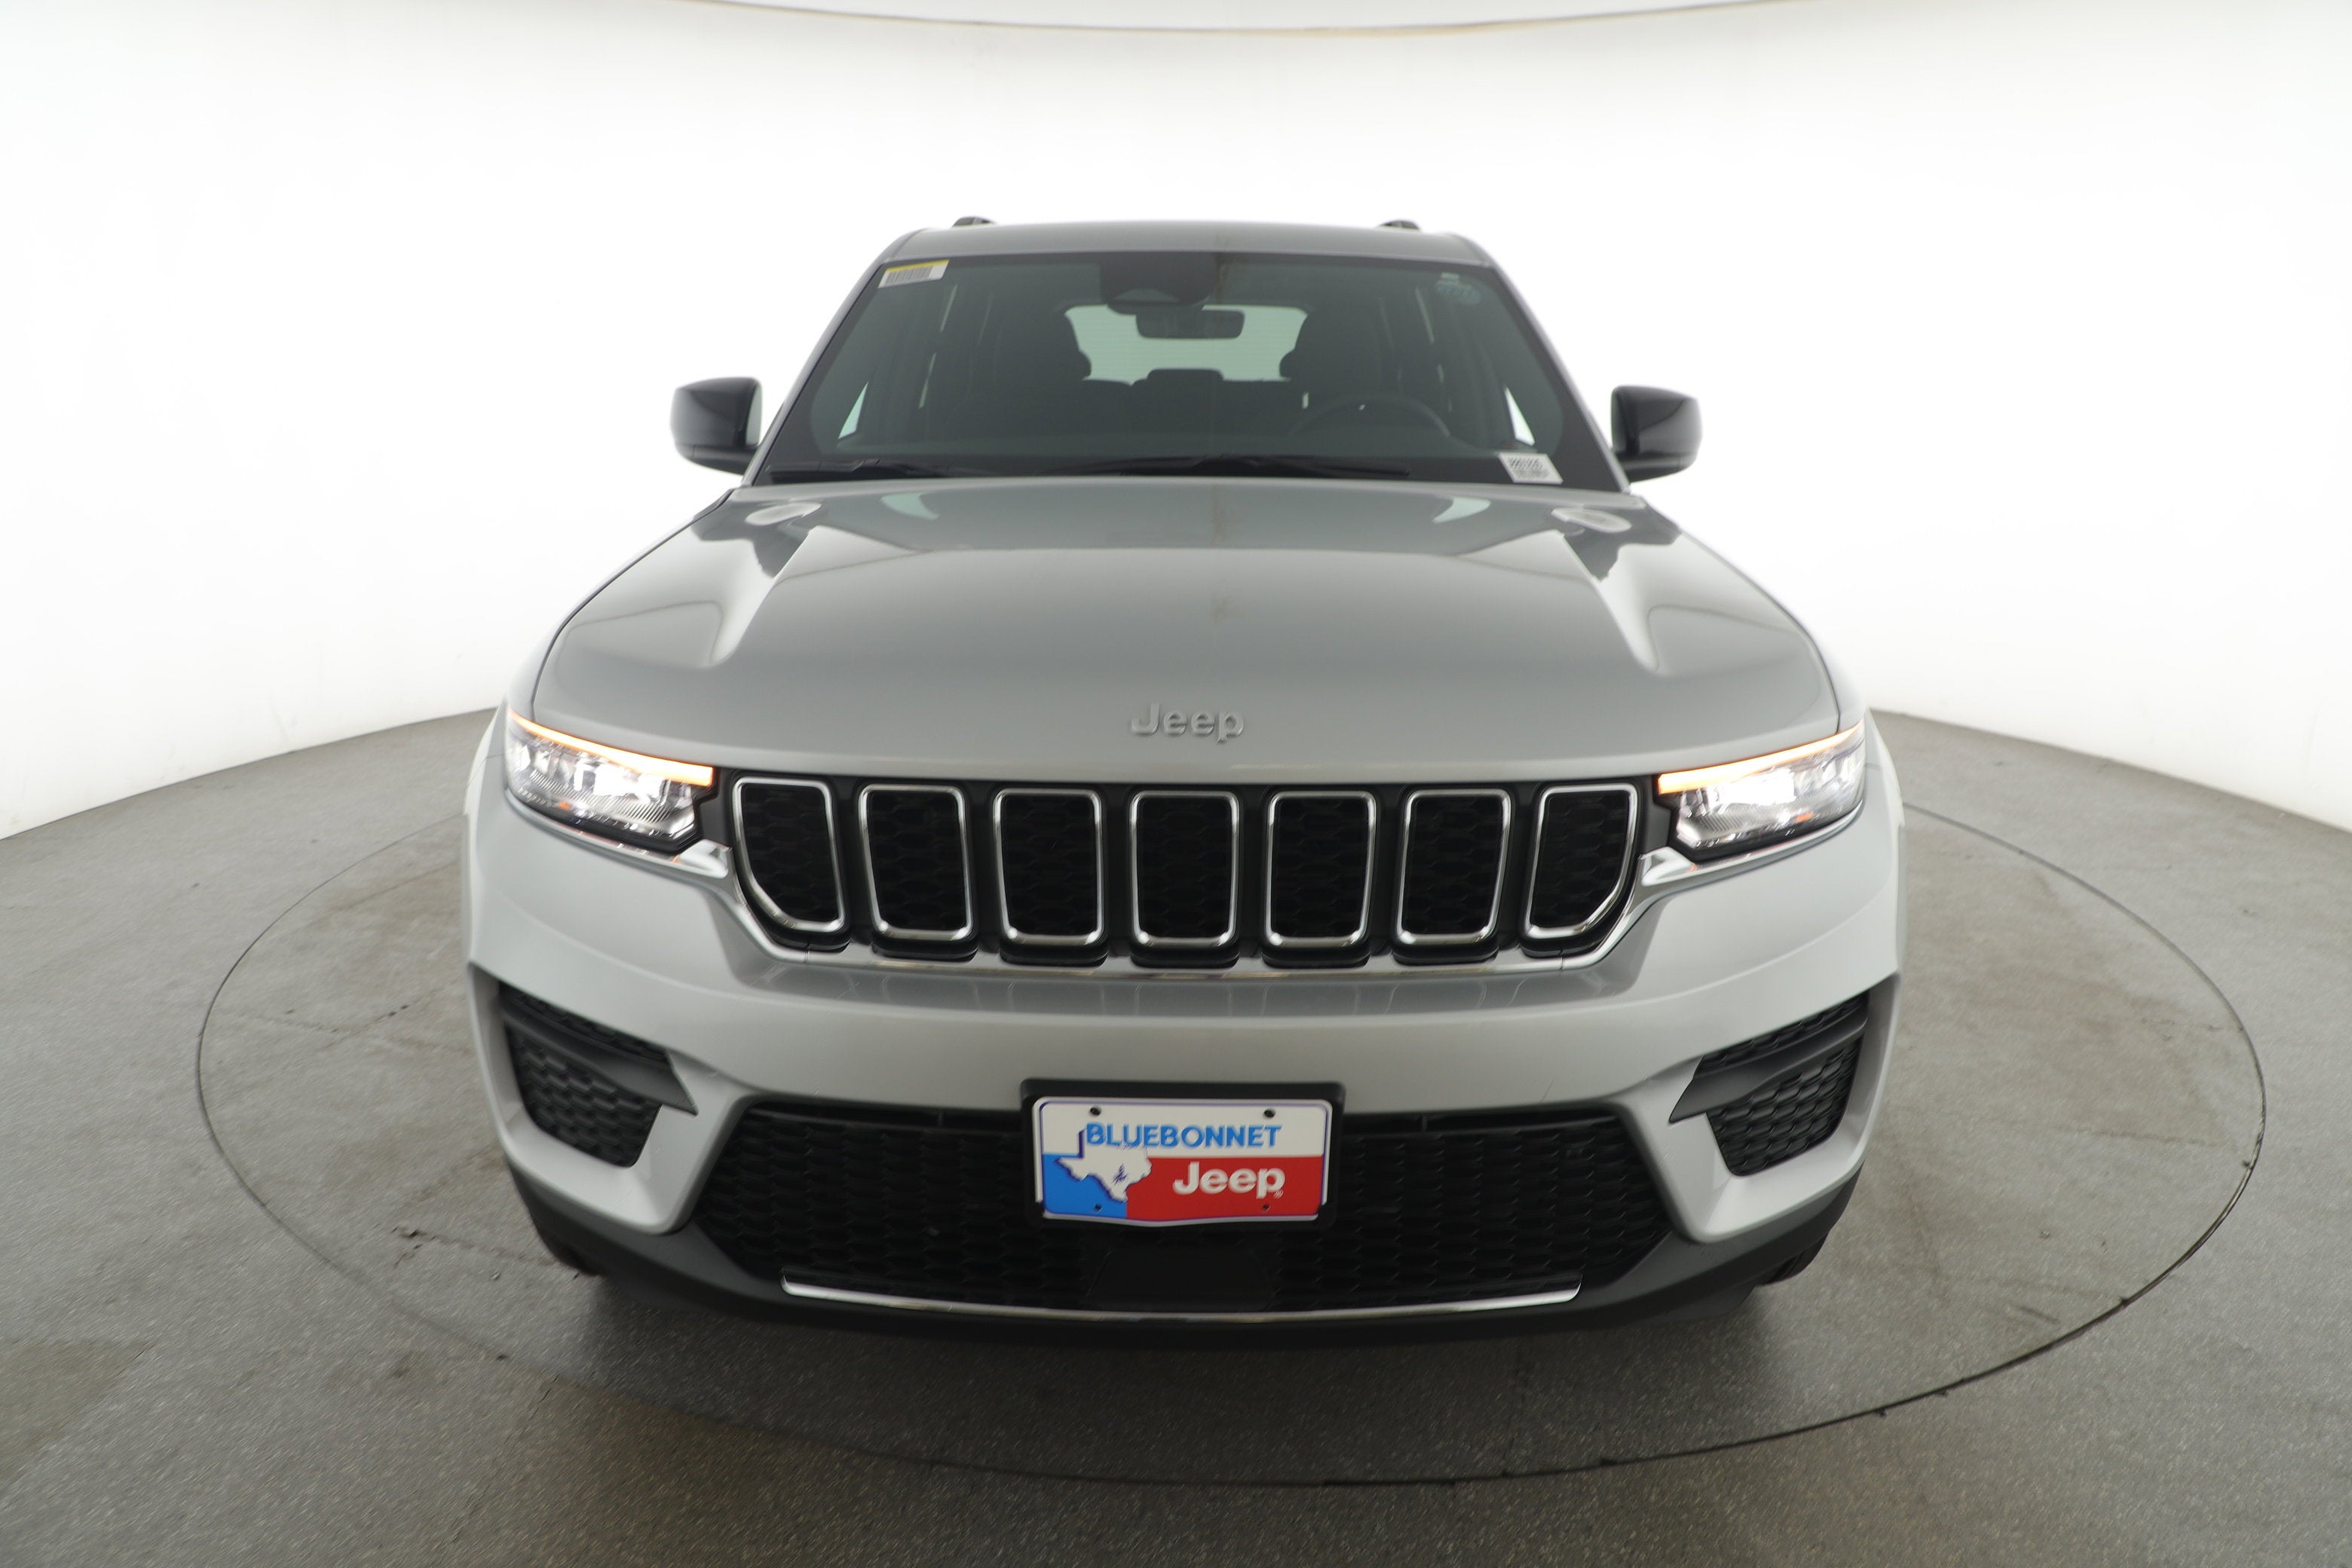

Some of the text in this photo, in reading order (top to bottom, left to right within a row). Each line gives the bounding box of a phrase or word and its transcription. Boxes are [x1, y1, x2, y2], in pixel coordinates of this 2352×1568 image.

[1131, 703, 1244, 743] Jeep
[1086, 1123, 1282, 1148] BLUEBONNET
[1172, 1161, 1286, 1199] Jeep
